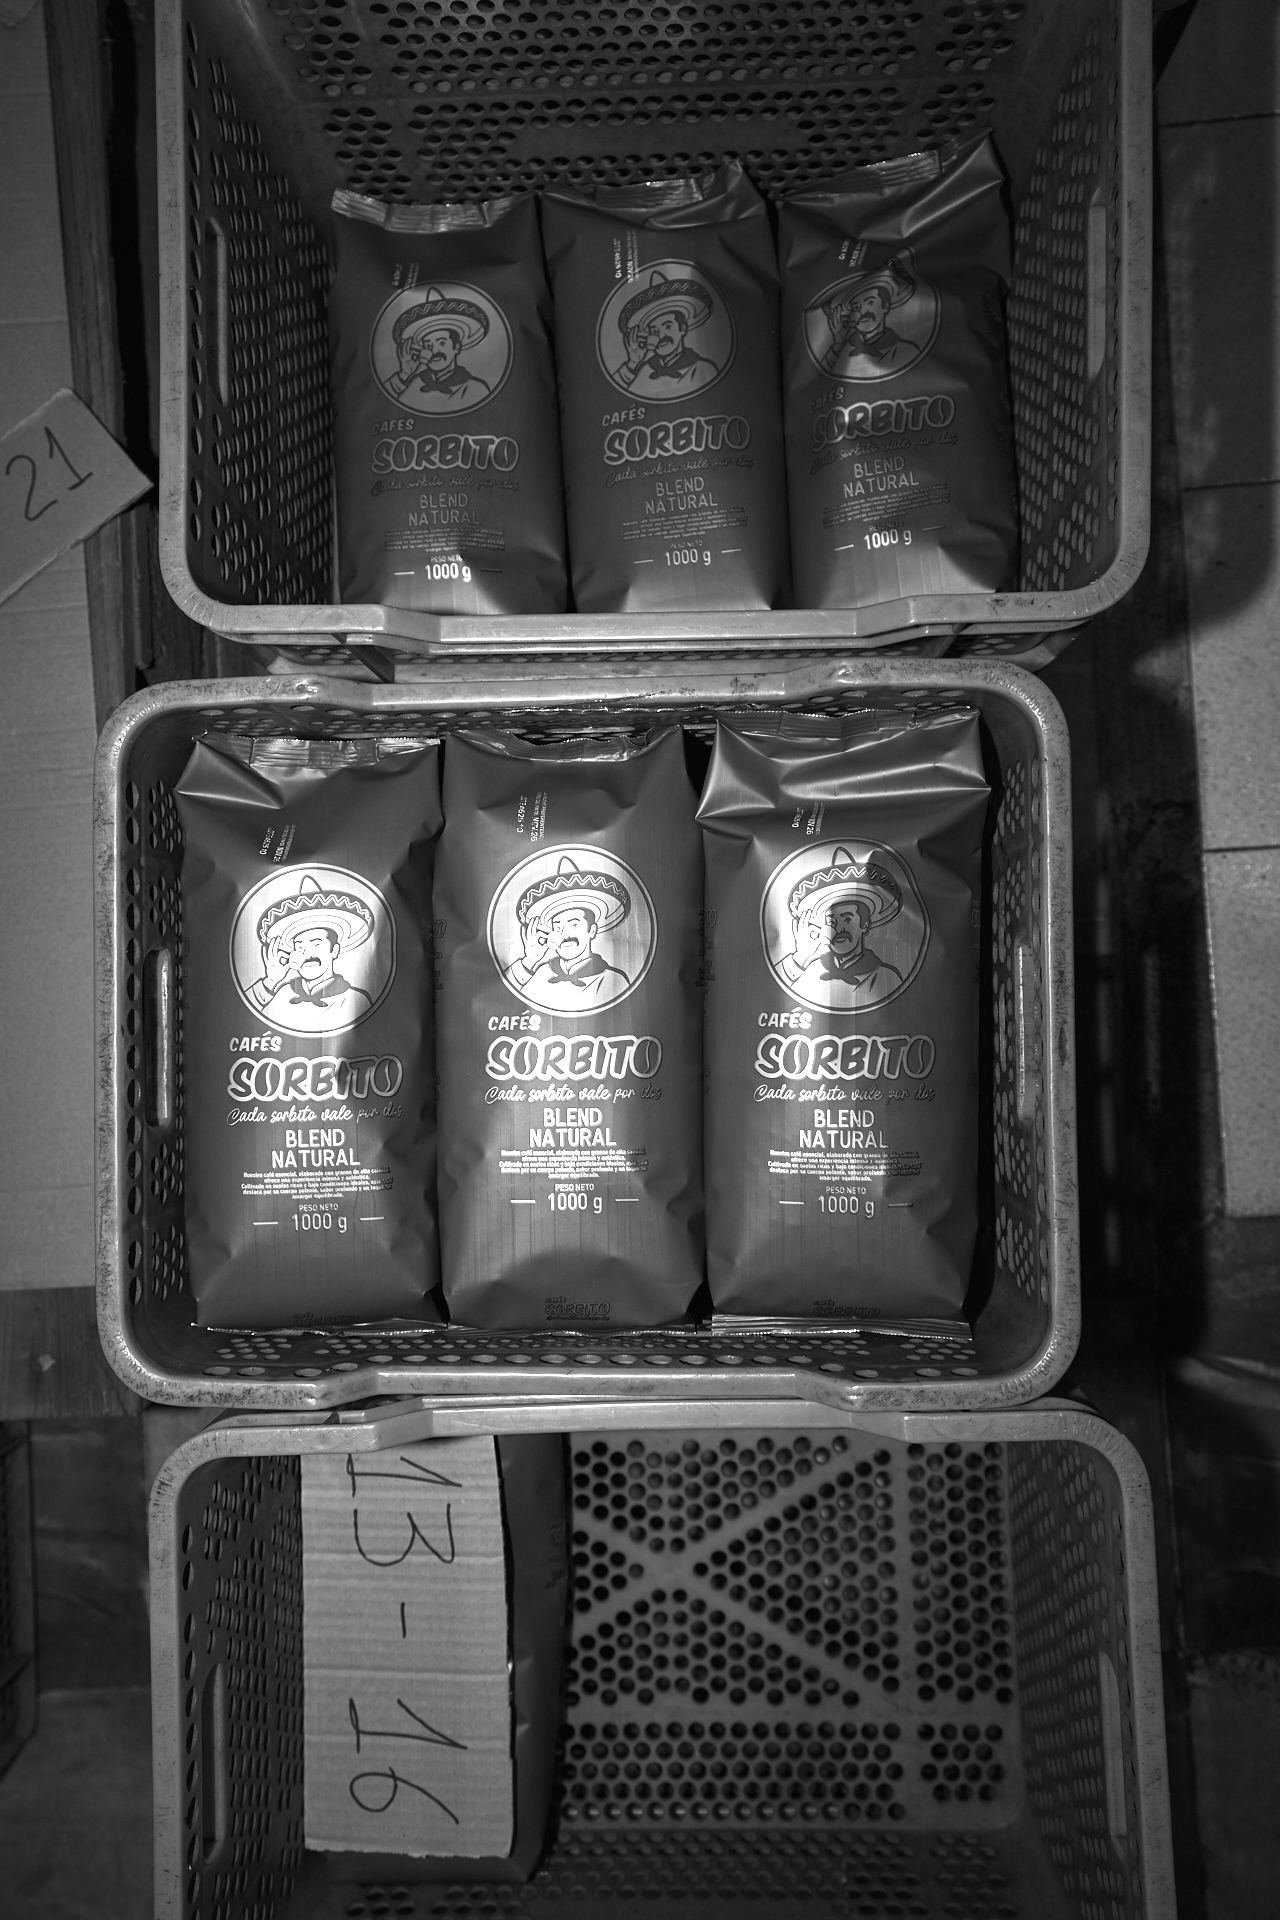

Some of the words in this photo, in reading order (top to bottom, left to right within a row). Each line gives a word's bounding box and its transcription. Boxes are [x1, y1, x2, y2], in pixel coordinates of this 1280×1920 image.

[372, 414, 415, 435] CAFÉS
[602, 403, 647, 428] CAFÉS
[811, 394, 956, 453] SORBITO
[604, 414, 751, 465] SORBITO
[372, 434, 520, 474] SORBITO
[5, 425, 94, 522] 21
[853, 456, 905, 479] BLEND
[655, 476, 705, 497] BLEND
[842, 471, 920, 499] NATURAL
[420, 492, 469, 509] BLEND
[645, 491, 718, 515] NATURAL
[408, 509, 482, 526] NATURAL
[864, 529, 899, 551] 1000
[903, 529, 913, 546] g
[665, 548, 698, 566] 1000
[703, 550, 712, 566] g
[425, 562, 460, 580] 1000
[461, 565, 472, 583] g
[488, 1010, 541, 1031] CAFÉS
[758, 1007, 813, 1029] CAFÉS
[229, 1031, 283, 1053] CAFÉS
[485, 1035, 662, 1081] SORBITO
[755, 1033, 936, 1081] SORBITO
[227, 1056, 403, 1102] SORBITO
[485, 1084, 527, 1105] Cada
[528, 1083, 576, 1103] sorbito
[579, 1083, 611, 1101] vale
[613, 1088, 637, 1104] por
[754, 1084, 796, 1103] Cada
[799, 1084, 847, 1103] sorbito
[852, 1085, 884, 1101] vale
[228, 1106, 267, 1126] Cada
[270, 1104, 317, 1123] sorbito
[321, 1104, 354, 1121] vale
[357, 1109, 379, 1123] por
[383, 1102, 403, 1117] dos
[543, 1107, 604, 1128] BLEND
[815, 1108, 876, 1129] BLEND
[285, 1128, 346, 1148] BLEND
[530, 1127, 618, 1148] NATURAL
[799, 1129, 891, 1149] NATURAL
[271, 1148, 361, 1169] NATURAL
[555, 1182, 575, 1192] PESO
[576, 1182, 596, 1191] NETO
[825, 1186, 846, 1195] PESO
[847, 1185, 868, 1195] NETO
[299, 1204, 319, 1212] PESO
[320, 1203, 340, 1211] NETO
[548, 1193, 588, 1212] 1000
[593, 1196, 604, 1215] g
[818, 1195, 860, 1215] 1000
[865, 1200, 876, 1219] g
[292, 1212, 333, 1231] 1000
[338, 1215, 349, 1234] g
[349, 1452, 464, 1567] 13
[349, 1697, 469, 1824] 16
